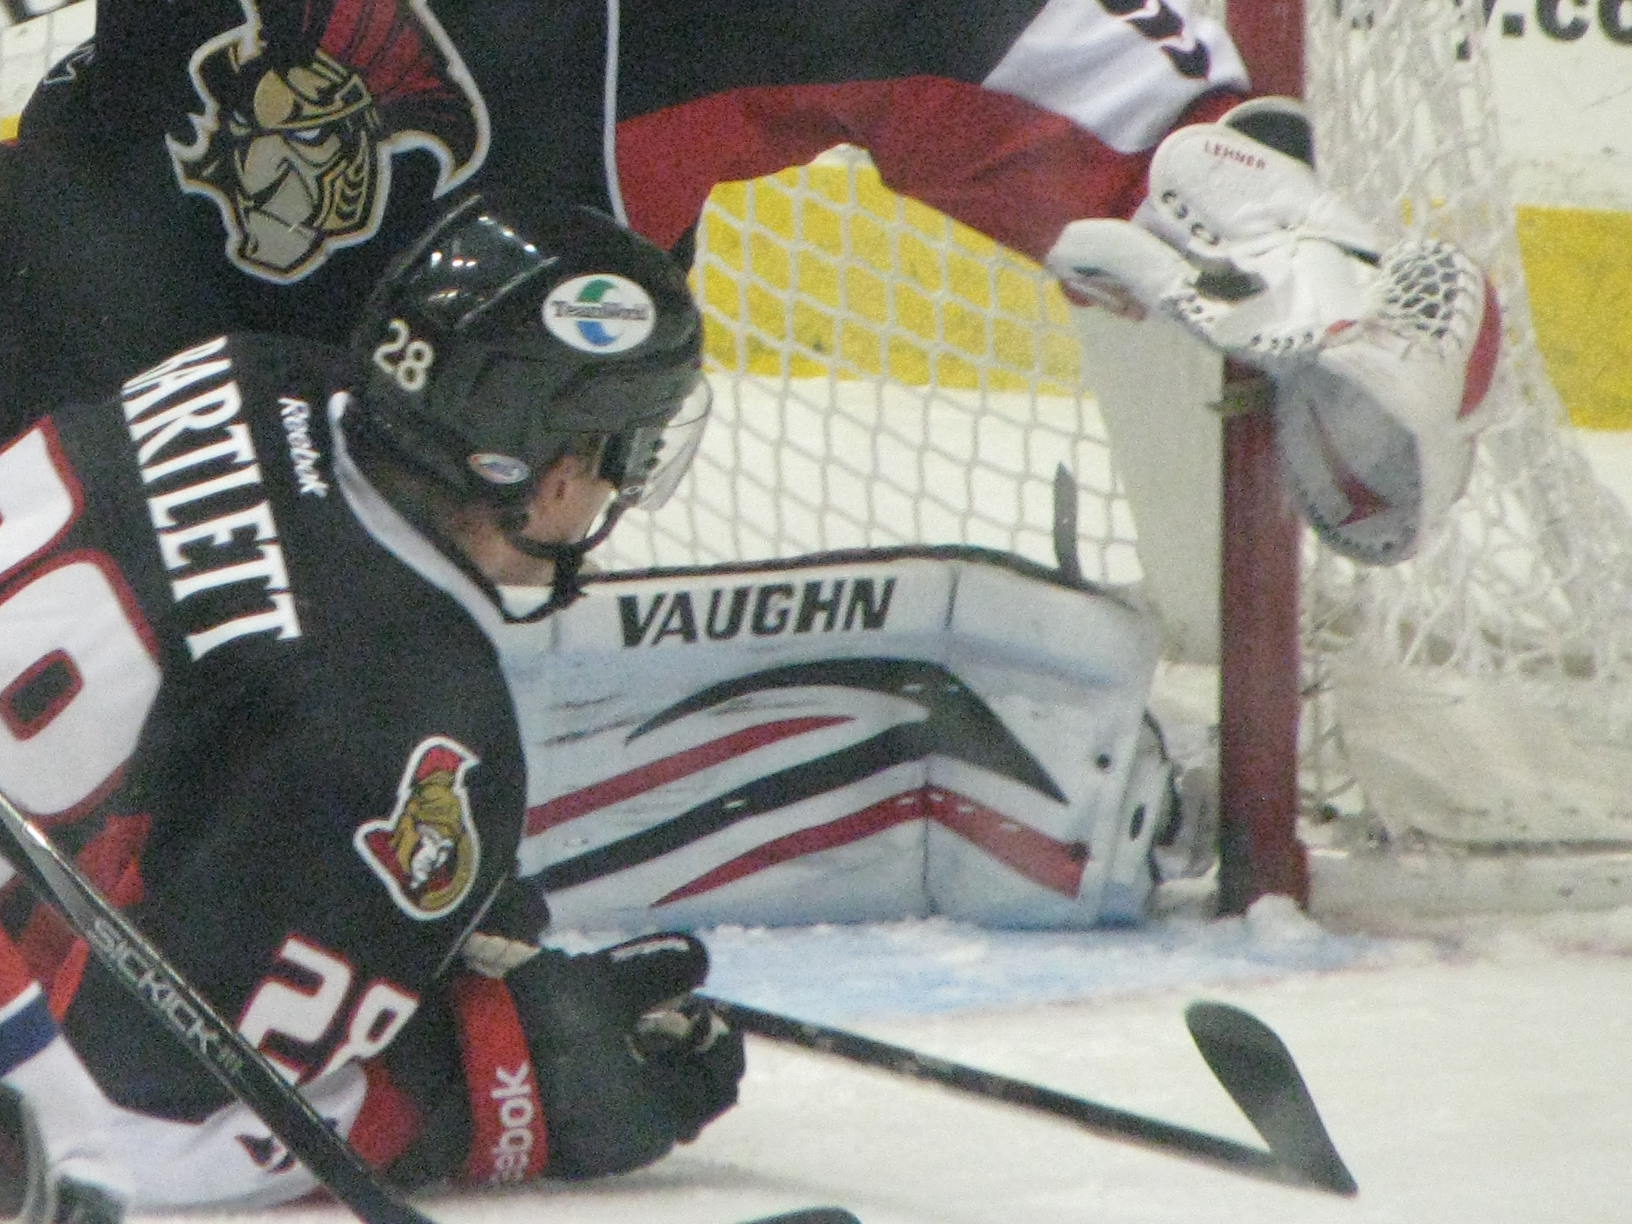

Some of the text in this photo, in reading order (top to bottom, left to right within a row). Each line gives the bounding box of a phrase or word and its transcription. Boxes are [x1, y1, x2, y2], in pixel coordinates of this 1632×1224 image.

[1204, 139, 1267, 171] LEHNER
[372, 317, 435, 393] 28
[617, 576, 898, 649] VAUGHN
